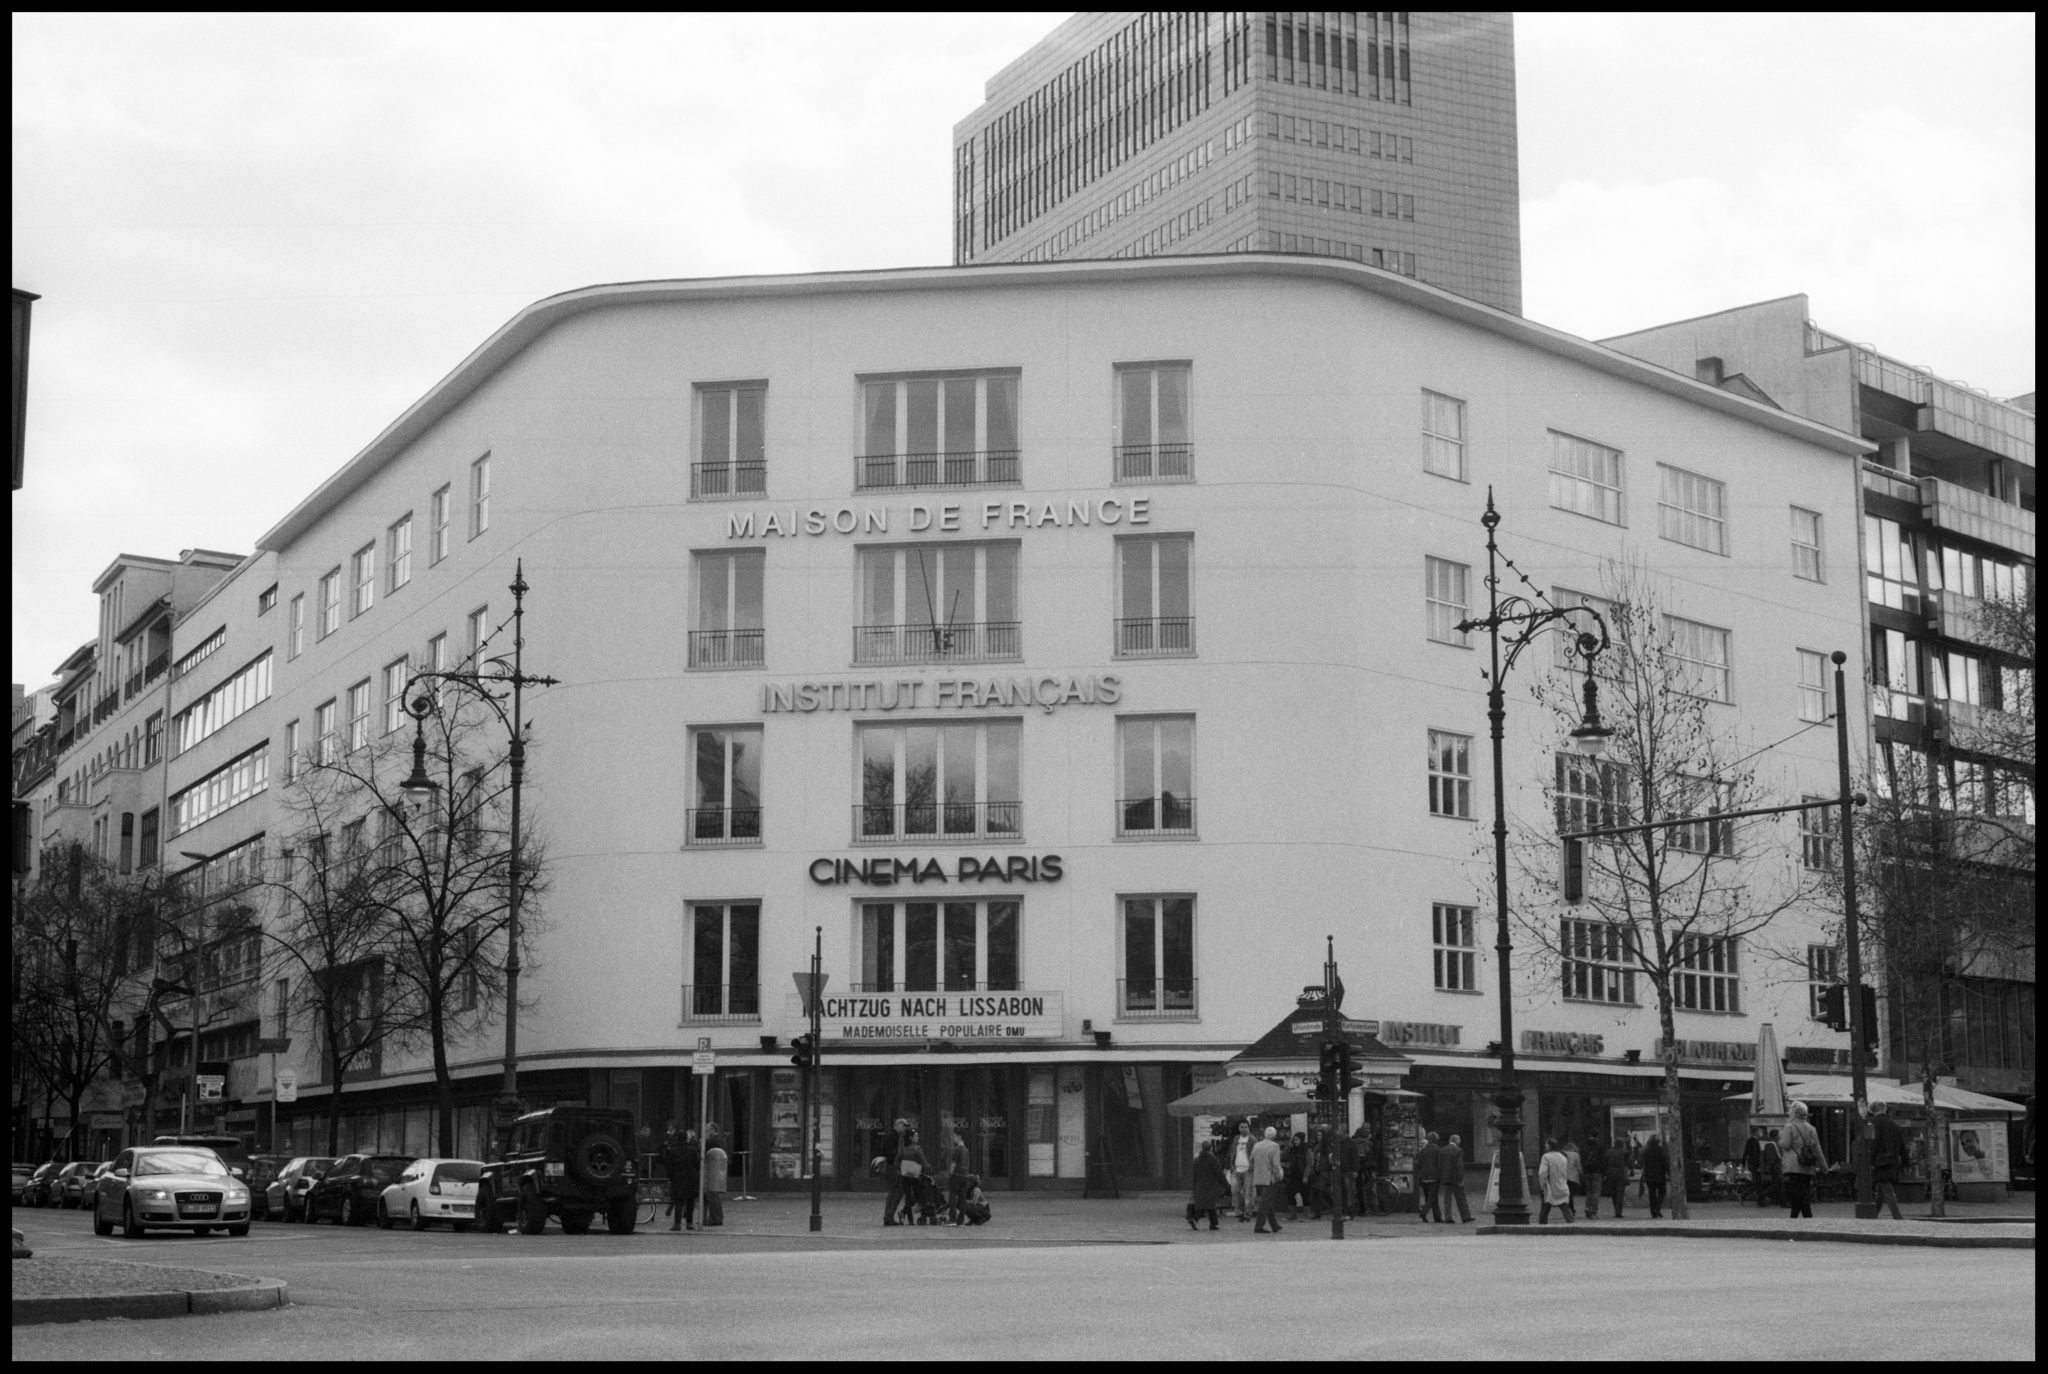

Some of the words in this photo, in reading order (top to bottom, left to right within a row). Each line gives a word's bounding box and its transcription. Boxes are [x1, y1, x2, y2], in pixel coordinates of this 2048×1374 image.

[727, 505, 889, 540] MAISON
[910, 504, 961, 532] DE
[981, 497, 1150, 530] FRANCE
[761, 679, 925, 713] INSTITUT
[935, 673, 1122, 715] FRANÇAIS
[809, 857, 949, 885] CINEMA
[958, 854, 1063, 884] PARIS
[901, 998, 947, 1017] NACH
[960, 997, 1044, 1017] LISSABON
[843, 1025, 929, 1039] MADEMOISELLE
[940, 1024, 1003, 1038] POPULAIRE
